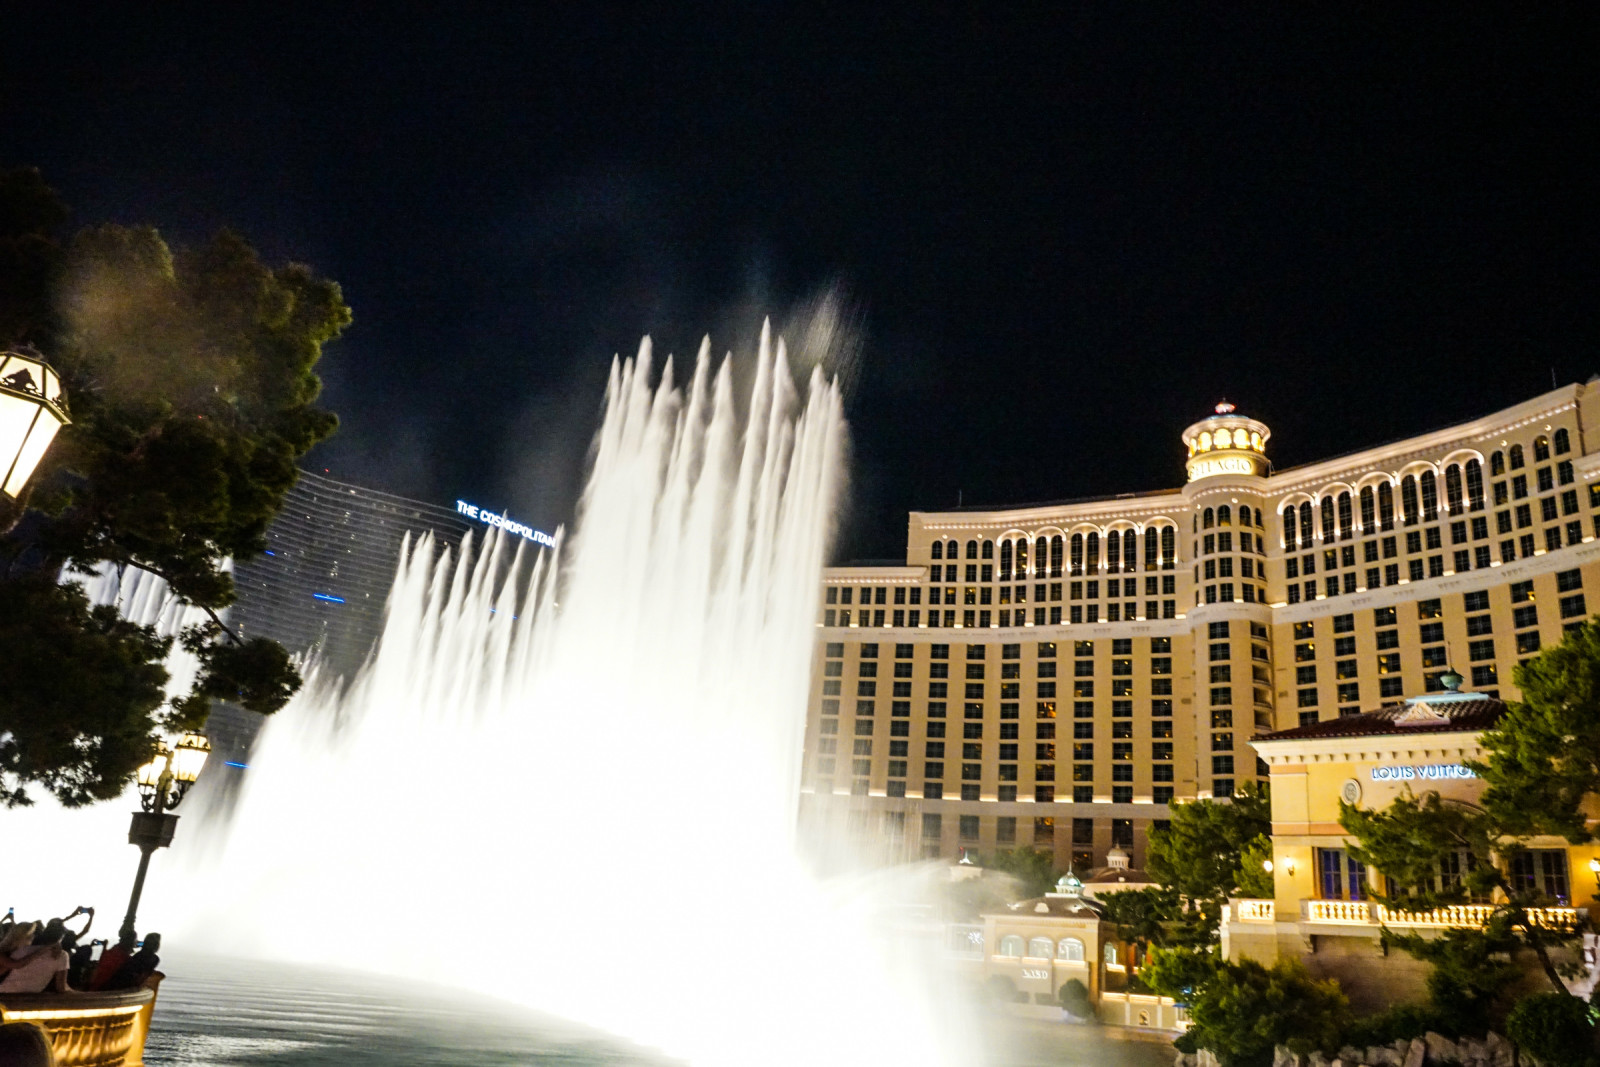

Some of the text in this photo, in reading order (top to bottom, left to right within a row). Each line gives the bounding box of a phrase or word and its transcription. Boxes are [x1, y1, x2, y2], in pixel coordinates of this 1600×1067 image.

[457, 500, 556, 547] THE COSMOPOLITAN
[1371, 766, 1415, 781] LOUIS
